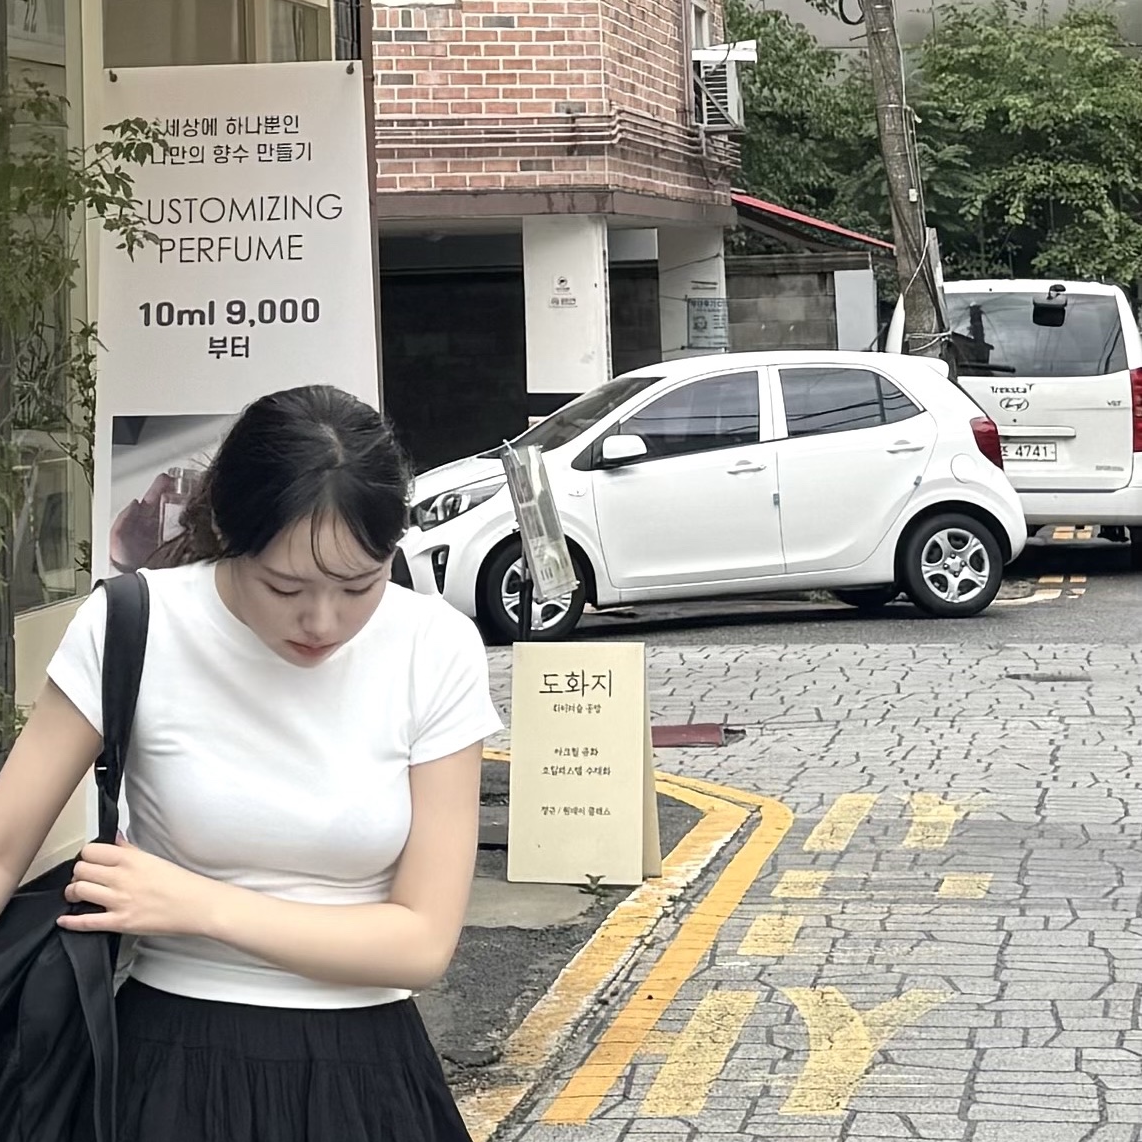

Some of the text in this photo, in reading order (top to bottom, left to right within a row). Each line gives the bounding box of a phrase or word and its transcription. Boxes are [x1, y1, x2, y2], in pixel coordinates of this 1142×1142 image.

[163, 115, 299, 137] 세상에 하나뿐인
[151, 142, 312, 165] 나만의 향수 만들기
[159, 234, 303, 263] PERFUME
[138, 298, 320, 327] 10ml 9,000
[208, 335, 250, 360] 부터
[1014, 444, 1048, 457] 4741
[539, 669, 612, 697] 도화지
